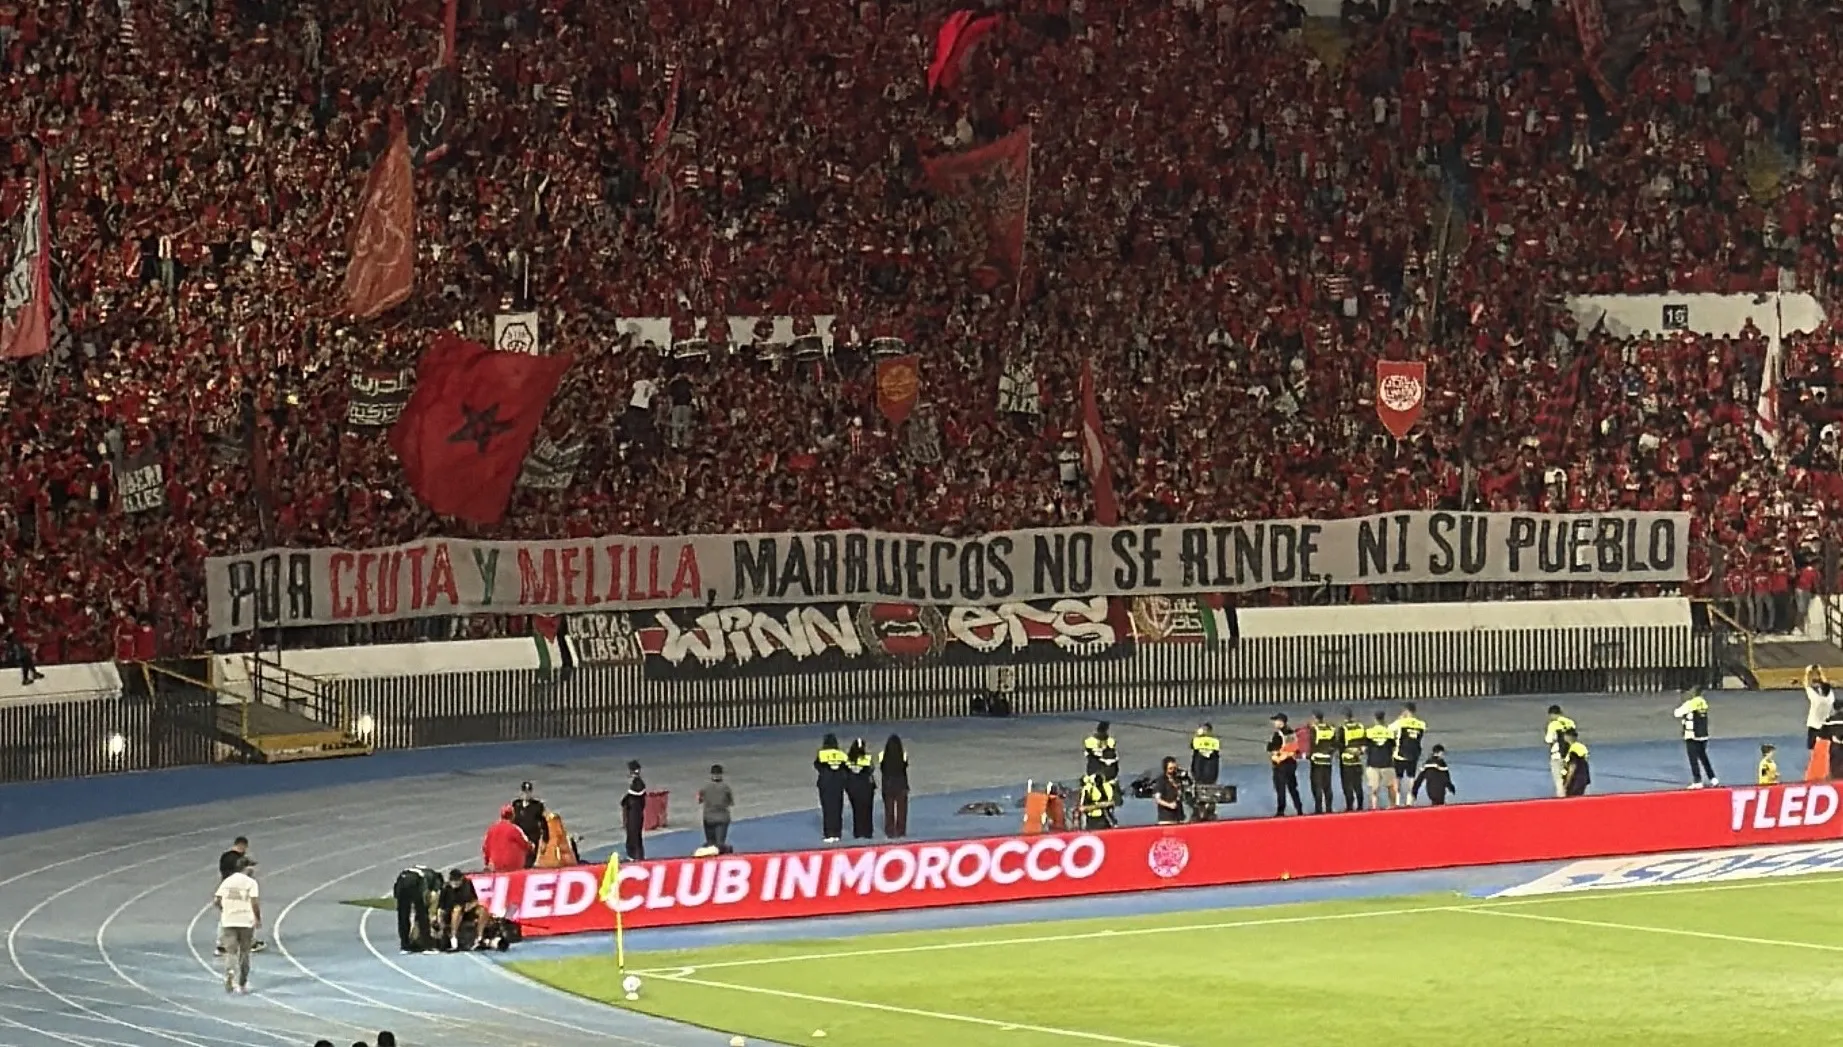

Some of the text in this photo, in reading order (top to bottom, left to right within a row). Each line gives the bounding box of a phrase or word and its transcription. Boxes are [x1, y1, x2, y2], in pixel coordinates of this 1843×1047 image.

[228, 553, 311, 627] POR
[329, 544, 459, 619] CEUTA
[473, 547, 500, 606] Y
[733, 534, 1014, 600] MARRUECOS
[1033, 531, 1094, 594] NO
[1113, 527, 1163, 590] SE
[1358, 515, 1411, 578] NI
[1428, 512, 1488, 576] SU
[1506, 516, 1677, 574] PUEBLO
[605, 859, 752, 913] CLUB
[760, 853, 823, 902] IN
[825, 834, 1105, 897] MOROCCO
